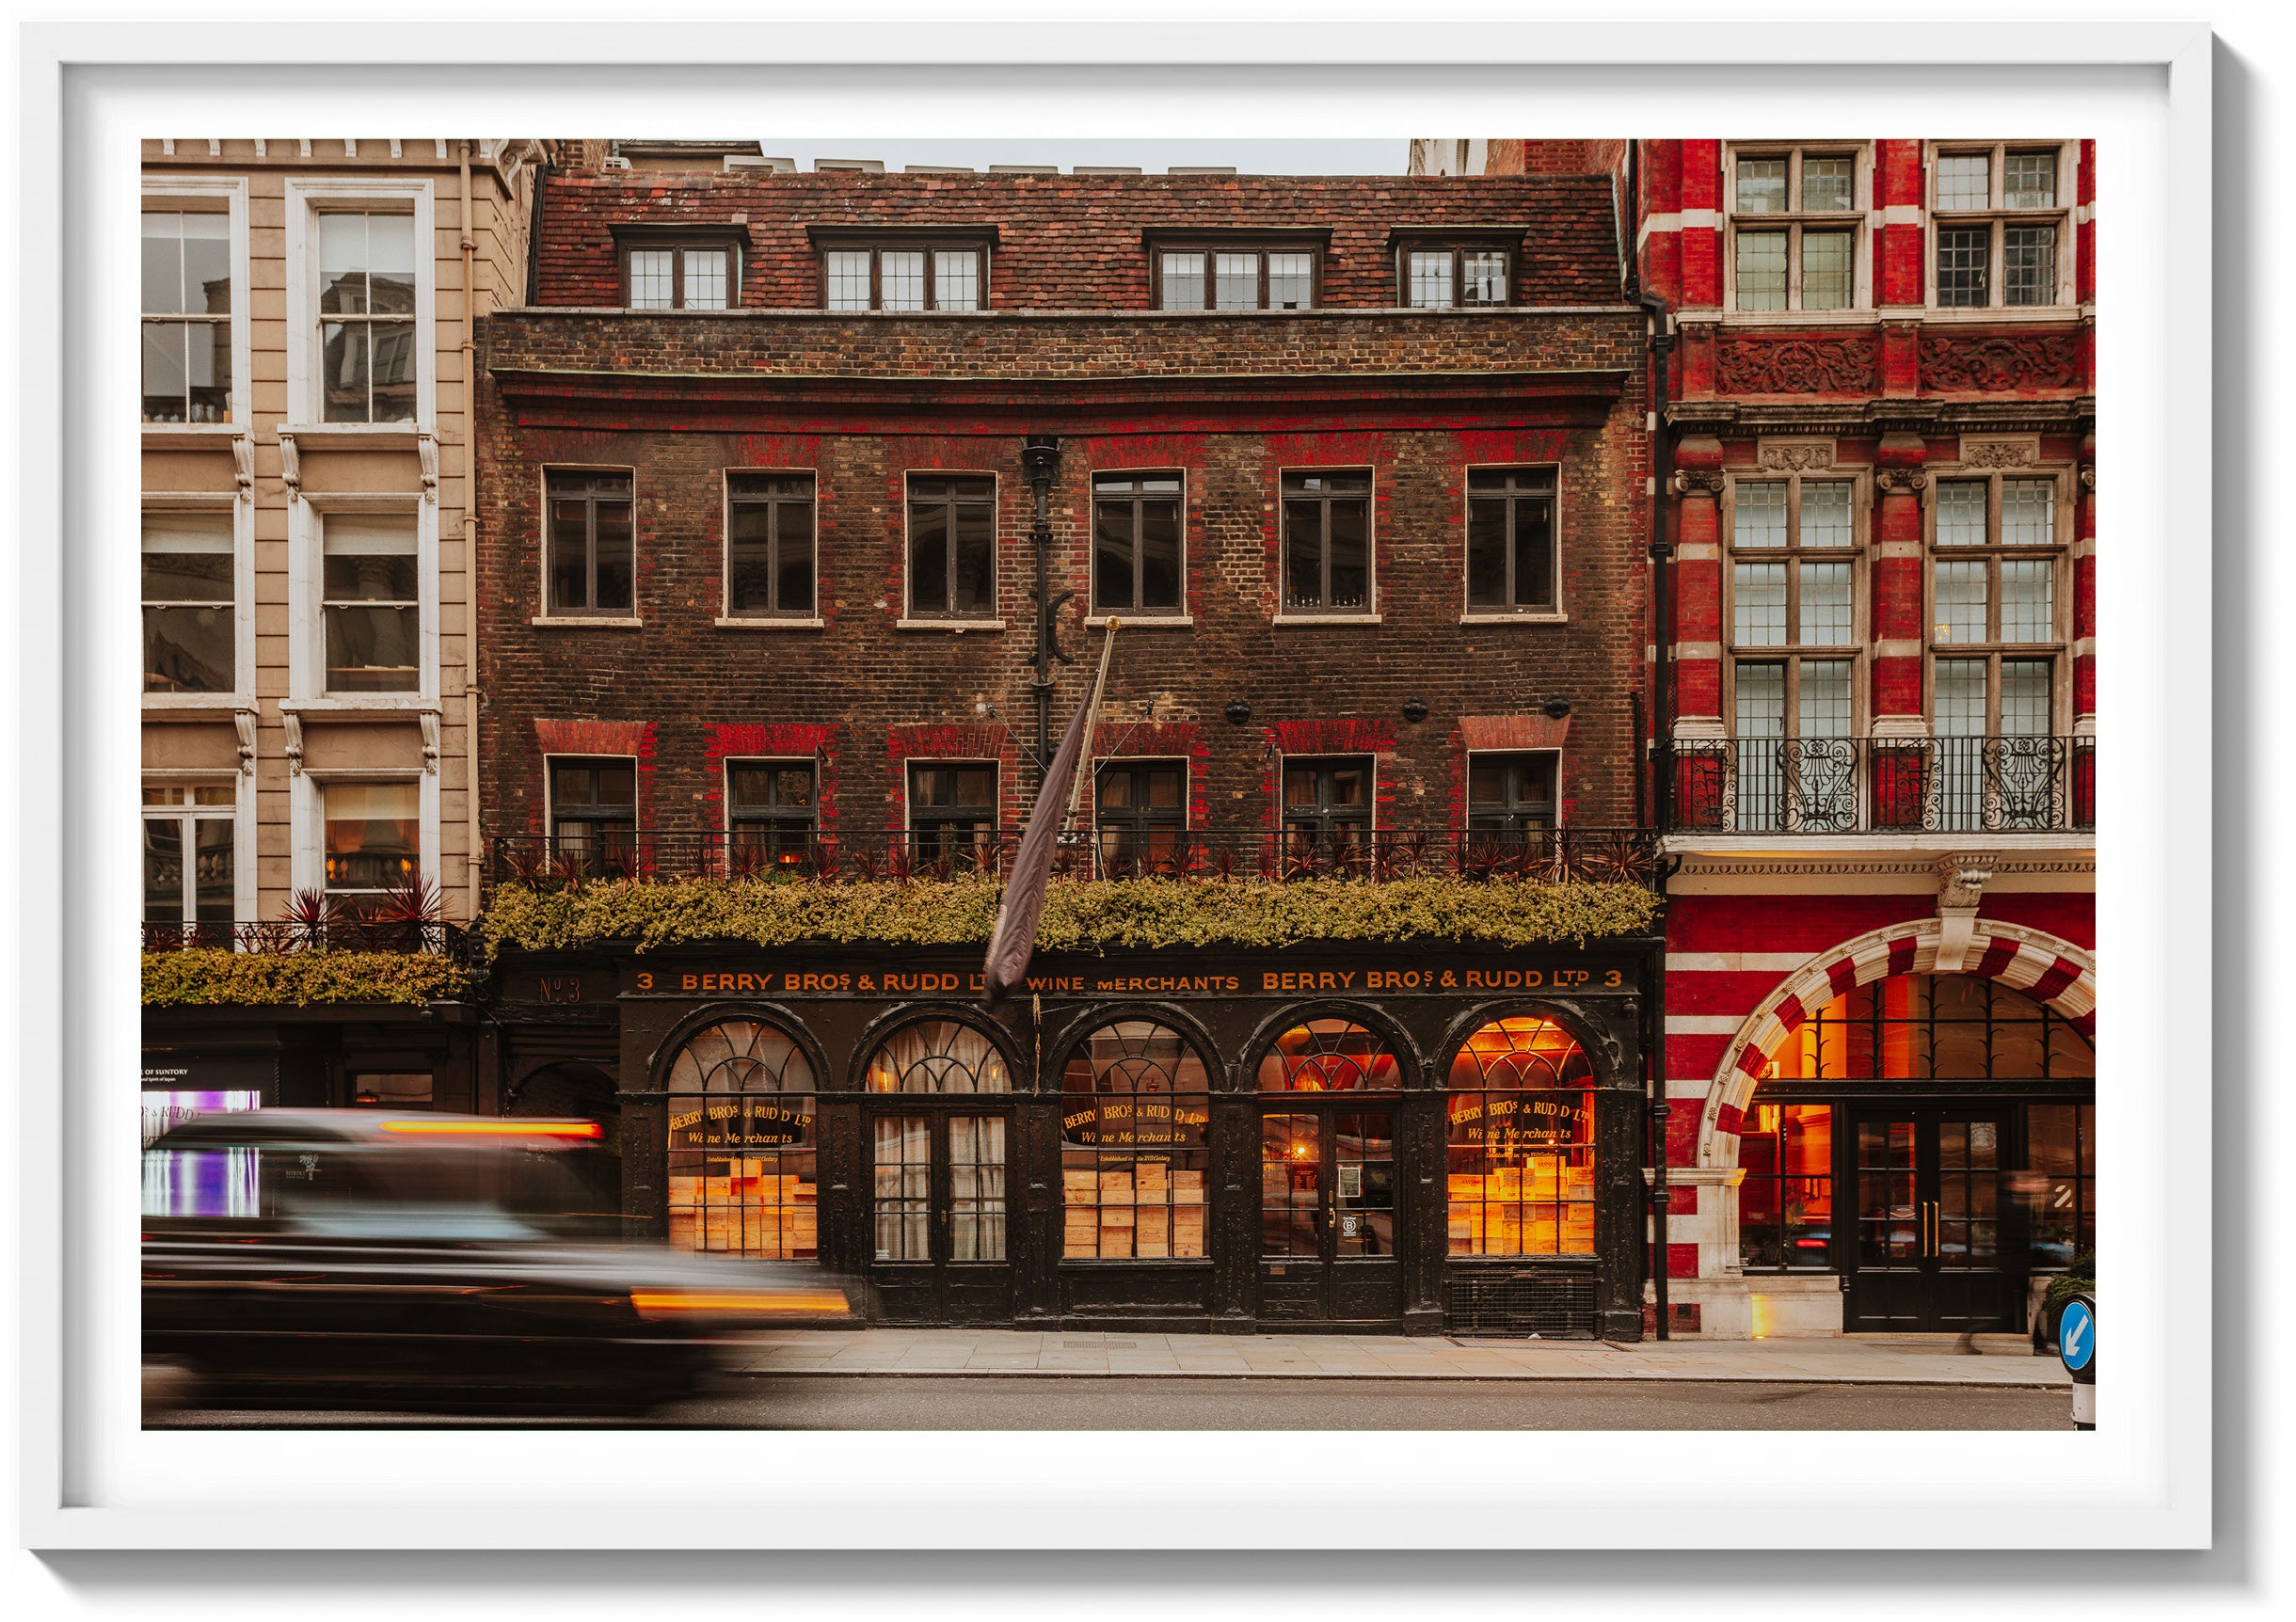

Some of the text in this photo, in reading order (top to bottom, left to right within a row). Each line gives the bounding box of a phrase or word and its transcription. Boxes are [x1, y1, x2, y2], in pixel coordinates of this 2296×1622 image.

[637, 972, 654, 990] 3
[682, 974, 773, 991] BERRY
[858, 974, 877, 991] &
[883, 973, 959, 991] RUDD
[1026, 976, 1240, 991] WINE MERCHANTS
[1262, 971, 1356, 990] BERRY
[1440, 970, 1459, 988] &
[1466, 970, 1543, 988] RUDD
[1603, 970, 1622, 988] 3
[568, 978, 581, 1003] 3
[162, 1105, 194, 1121] RUDD
[670, 1109, 703, 1130] BERRY
[743, 1107, 752, 1118] &
[755, 1105, 790, 1122] RUDD
[1063, 1108, 1097, 1130] BERRY
[1136, 1106, 1143, 1117] &
[1146, 1105, 1185, 1121] RUDD
[1450, 1105, 1483, 1126] BERRY
[1523, 1104, 1531, 1114] &
[1534, 1101, 1571, 1118] RUDD
[689, 1132, 792, 1144] Wine Merchants
[1082, 1131, 1187, 1143] Wine Merchants
[1468, 1127, 1571, 1139] Wine Merchants
